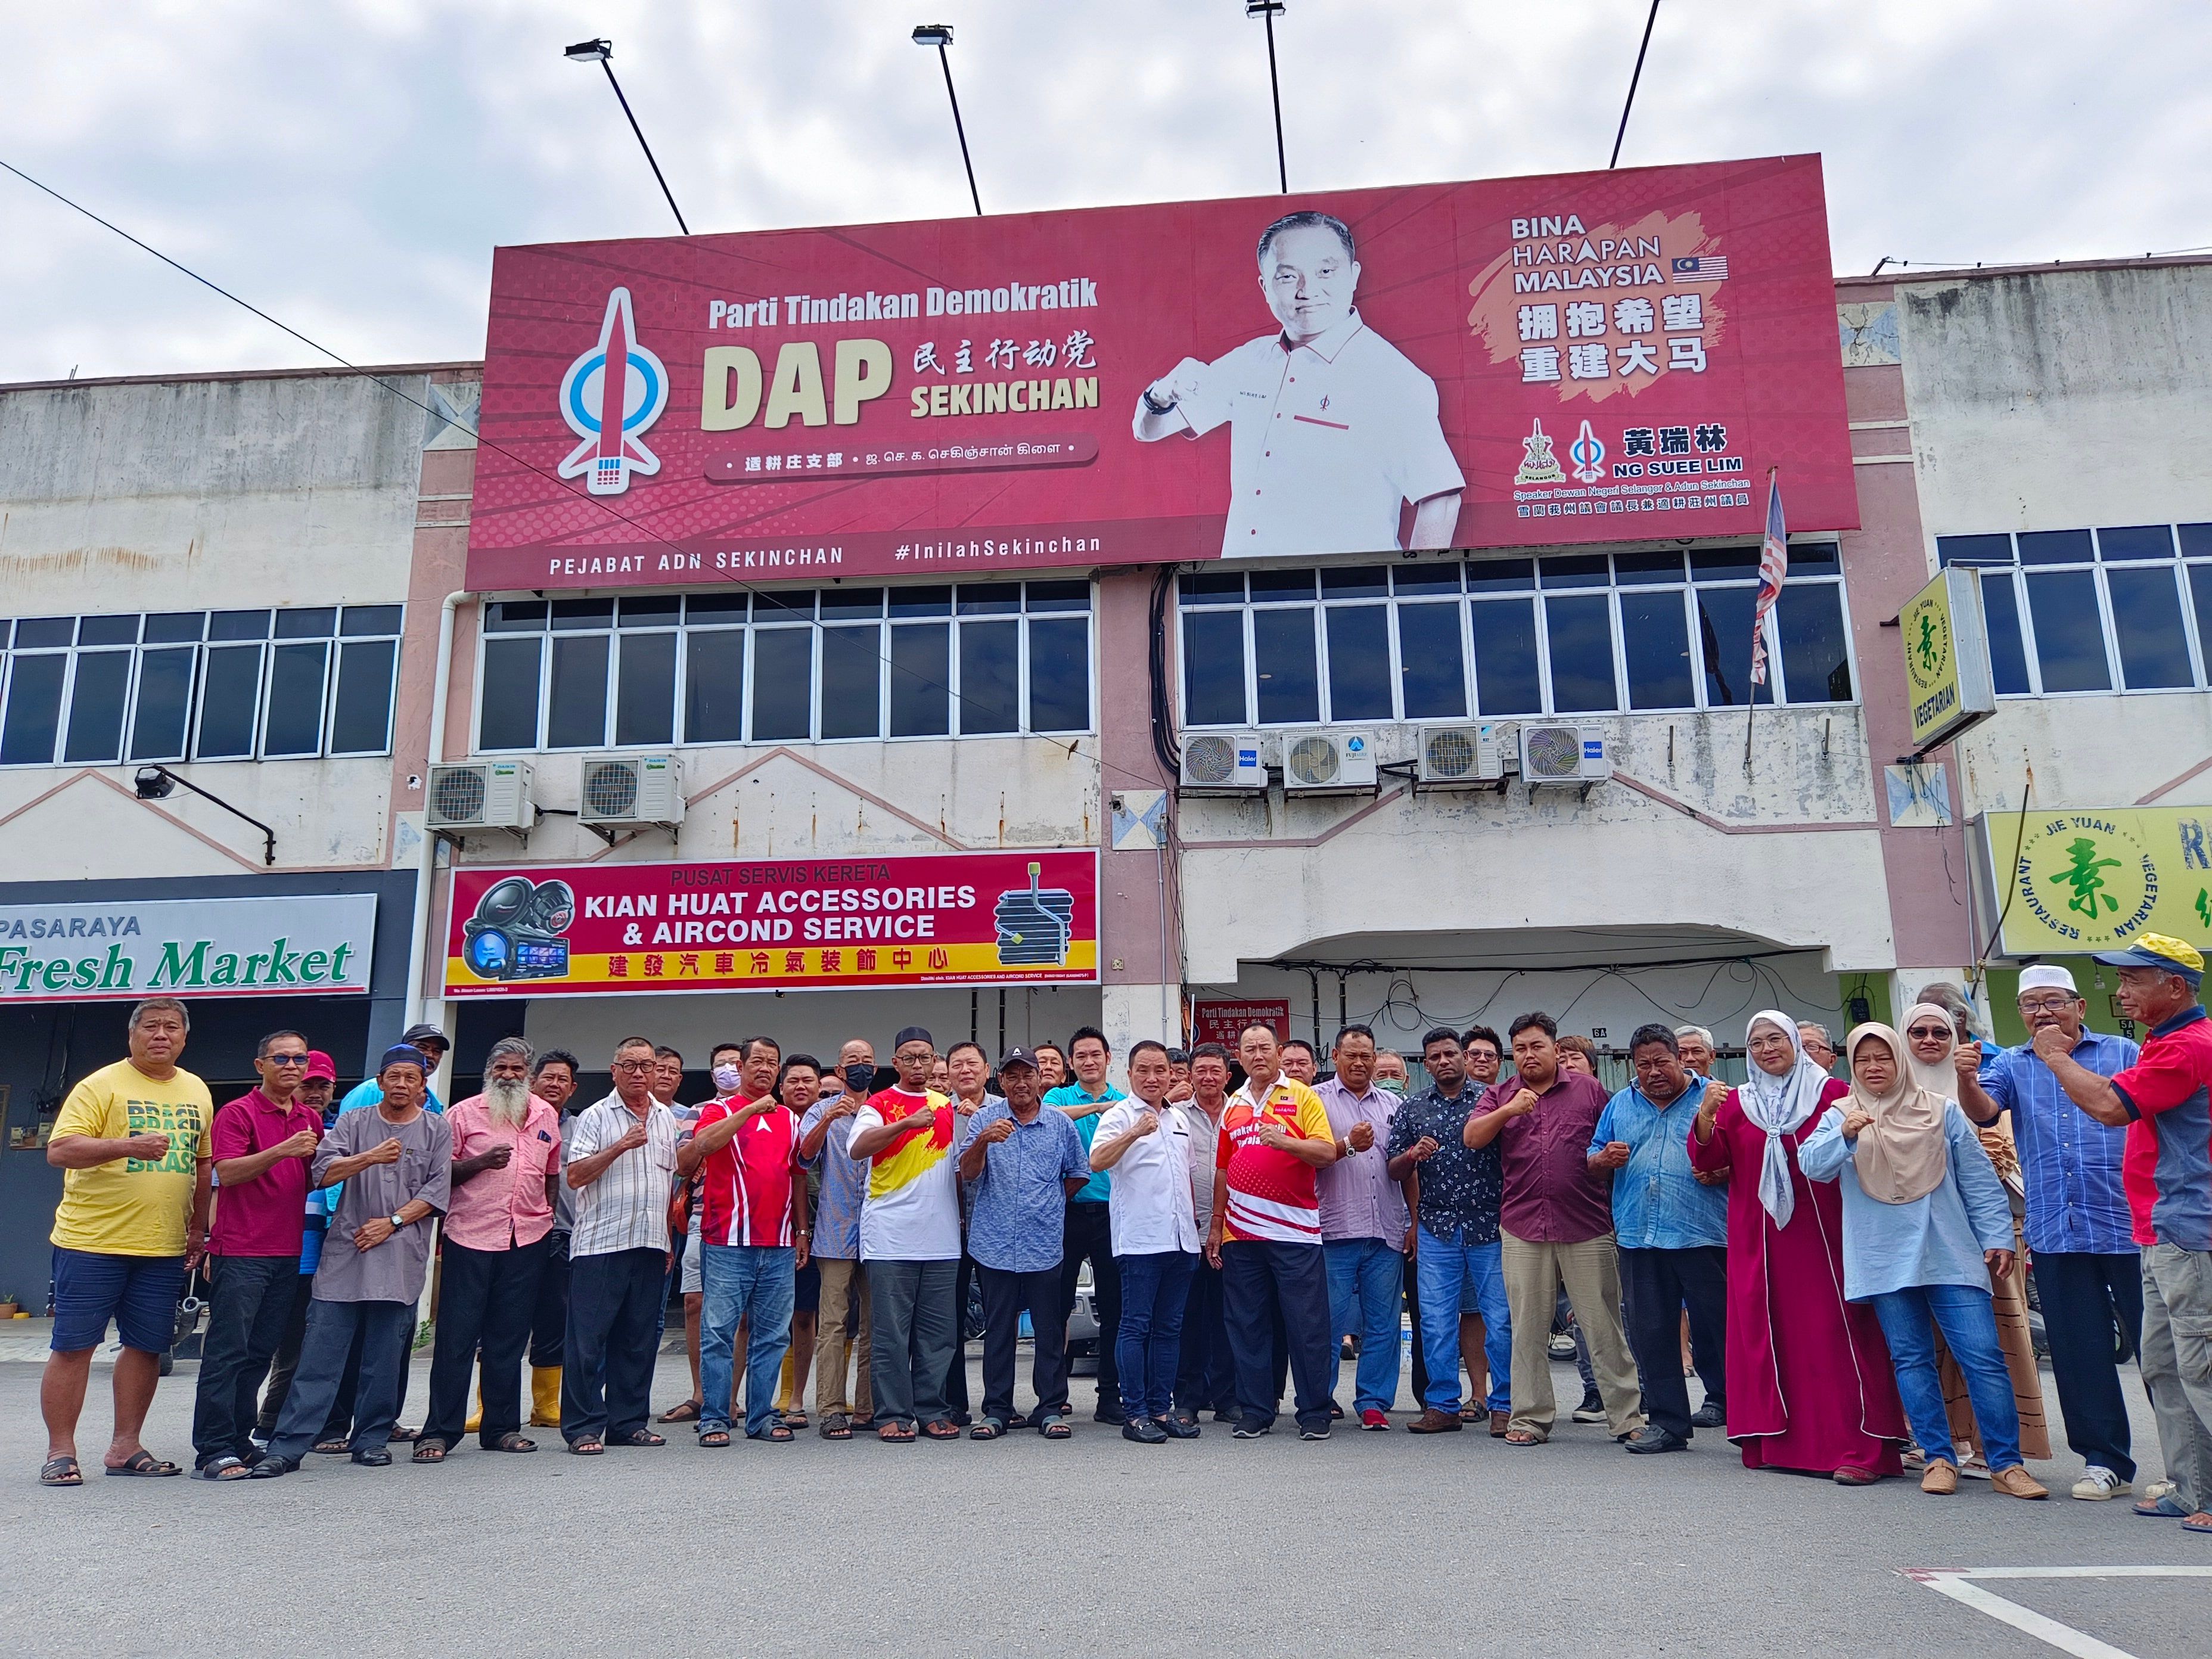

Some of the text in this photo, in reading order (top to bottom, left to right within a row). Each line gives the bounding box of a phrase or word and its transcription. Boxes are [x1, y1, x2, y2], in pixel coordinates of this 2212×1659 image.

[1511, 215, 1586, 238] BINA
[1513, 237, 1660, 266] HARAPAN
[1514, 263, 1664, 293] MALAYSIA
[709, 278, 1098, 329] Parti Tindakan Demokratik
[1518, 293, 1704, 340] 拥抱希望
[914, 330, 1097, 375] 民主行动党
[1520, 337, 1707, 382] 重建大马
[701, 338, 893, 431] DAP
[911, 377, 1098, 418] SEKINCHAN
[1614, 458, 1741, 477] NG SUEE LIM
[1514, 479, 1750, 501] Speaker Dewan Negeri Selangor & Adun Sekinchan
[549, 547, 843, 575] PEJABAT ADN SEKINCHAN
[895, 536, 1100, 560] #InilahSekinchan
[1920, 599, 1934, 610] YUAN
[1916, 615, 1937, 672] 素
[1914, 681, 1956, 729] VEGETARIAN
[2046, 817, 2115, 835] JIE YUAN
[671, 863, 890, 888] PUSAT SERVIS KERETA
[2049, 837, 2121, 920] 素
[585, 886, 975, 918] KIAN HUAT ACCESSORIES
[2018, 856, 2080, 940] RESTAURANT
[2113, 853, 2158, 938] VEGETARIAN
[0, 917, 141, 939] PASARAYA
[623, 915, 935, 945] & AIRCOND SERVICE
[0, 937, 353, 991] Fresh Market
[608, 947, 949, 978] 建發汽車冷氣裝飾中心
[1201, 1006, 1284, 1018] Parti Tindakan Demokratik
[2121, 1020, 2133, 1029] 5A
[1594, 1029, 1606, 1037] 6A
[2126, 1030, 2133, 1038] 5
